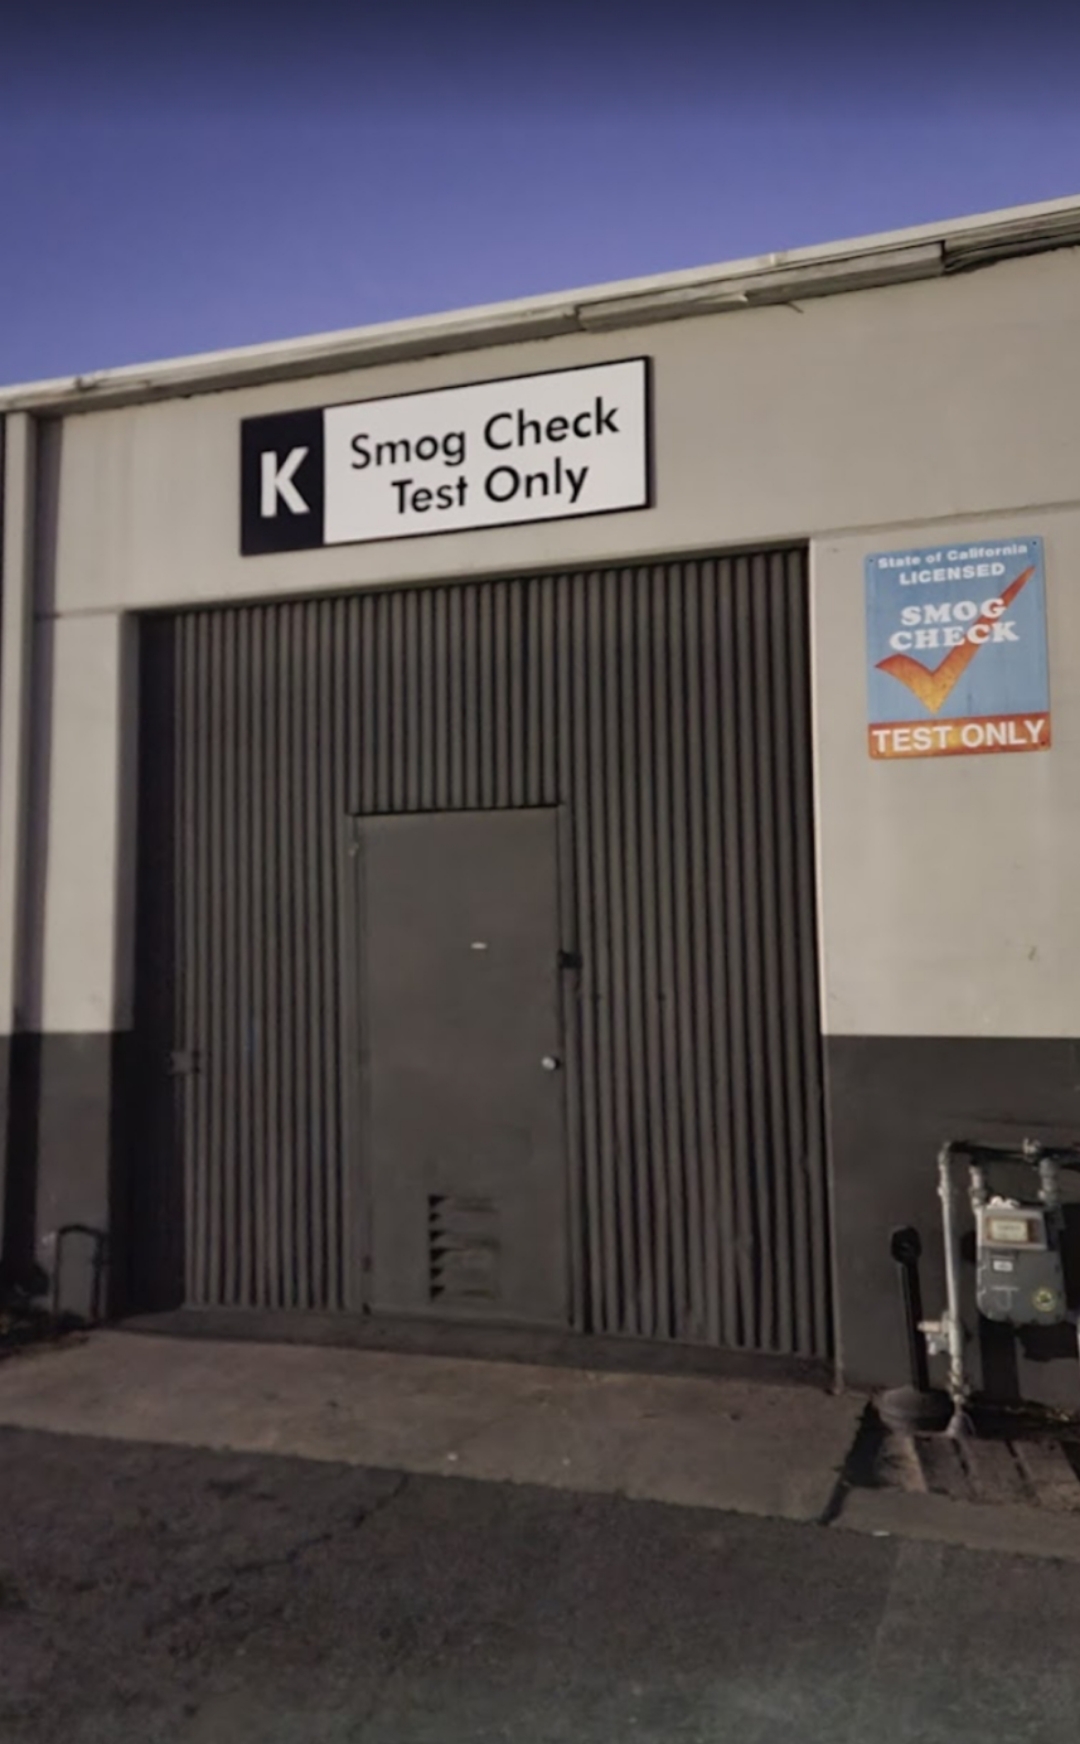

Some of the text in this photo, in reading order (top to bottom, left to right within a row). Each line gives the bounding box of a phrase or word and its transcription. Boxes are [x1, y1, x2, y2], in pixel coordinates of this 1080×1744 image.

[350, 396, 620, 470] Smog Check
[260, 446, 310, 518] K
[391, 457, 589, 514] Test Only
[877, 543, 1028, 569] State of California
[899, 562, 1006, 585] LICENSED
[901, 598, 1007, 626] SMOG
[889, 621, 1019, 651] CHECK
[872, 719, 1045, 753] TEST ONLY
